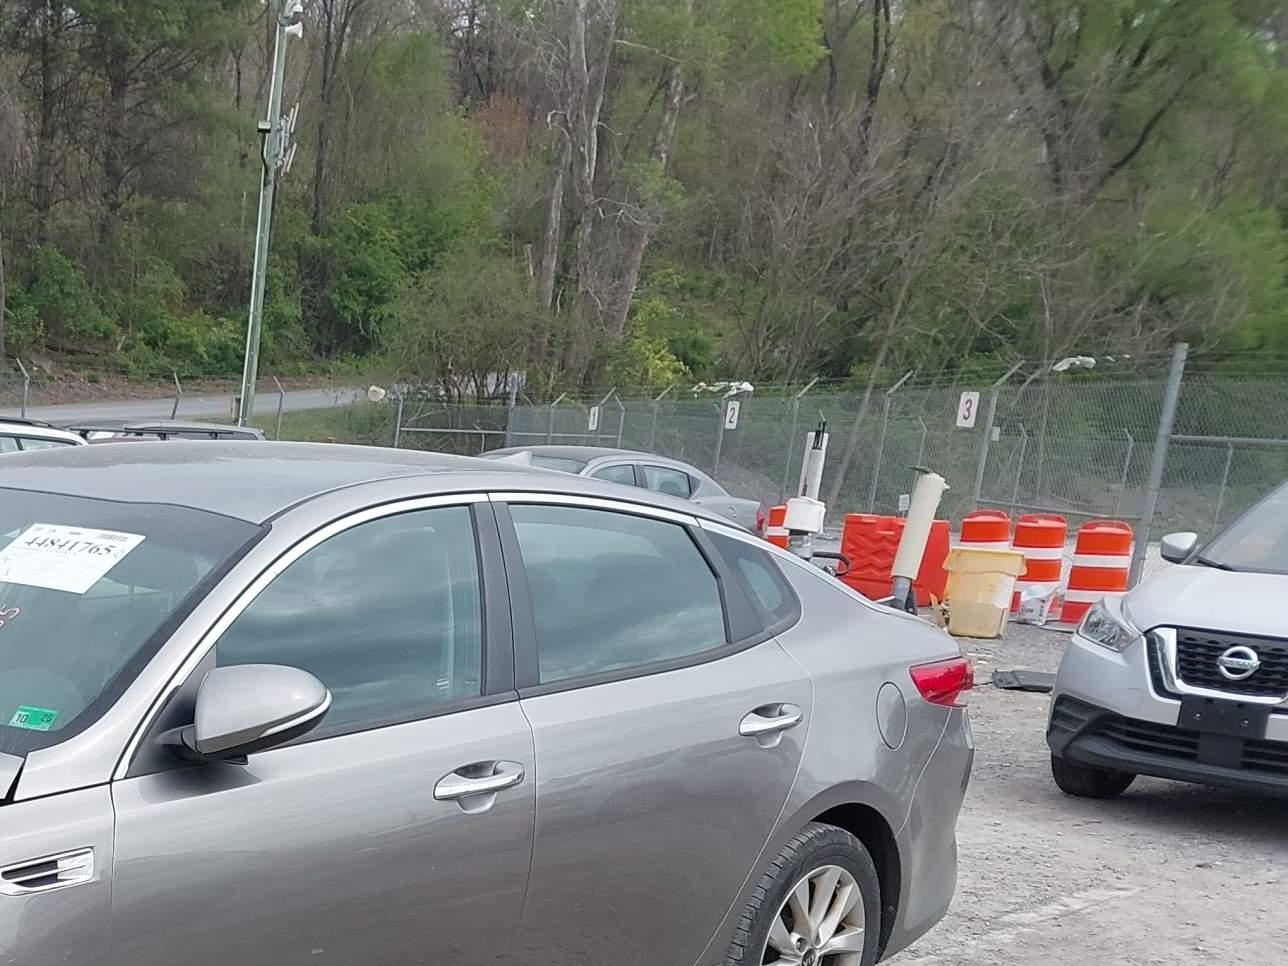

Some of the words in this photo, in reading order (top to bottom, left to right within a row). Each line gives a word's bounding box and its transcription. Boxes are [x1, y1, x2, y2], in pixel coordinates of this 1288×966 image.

[728, 407, 736, 424] 2
[962, 398, 973, 421] 3
[24, 536, 116, 556] 44841765
[16, 713, 29, 723] 10
